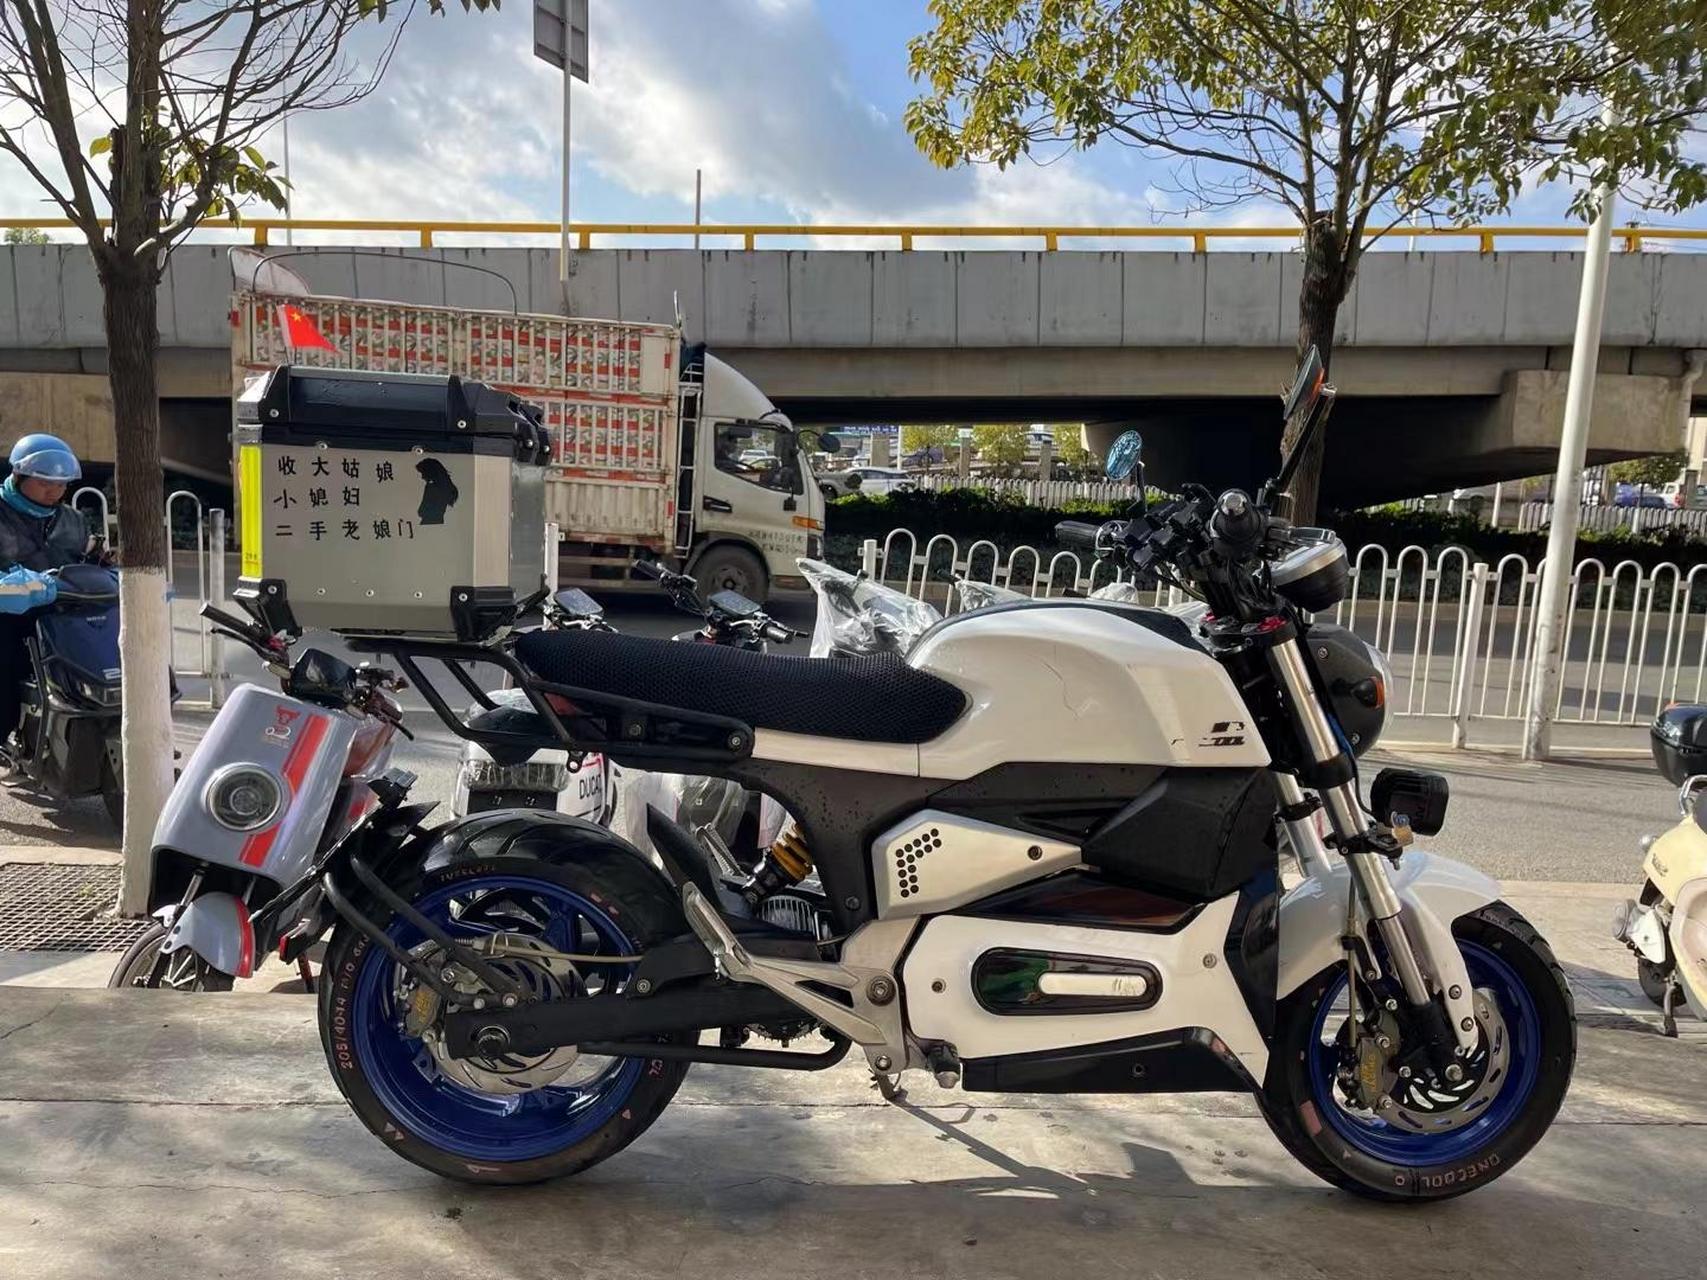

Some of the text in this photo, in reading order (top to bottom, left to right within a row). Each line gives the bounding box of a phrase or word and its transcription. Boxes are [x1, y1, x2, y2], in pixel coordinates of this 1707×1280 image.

[278, 455, 394, 483] 收大姑娘
[273, 486, 360, 509] 小媳妇
[275, 518, 414, 541] 二手老娘门
[1421, 1152, 1501, 1189] ONECOOL
